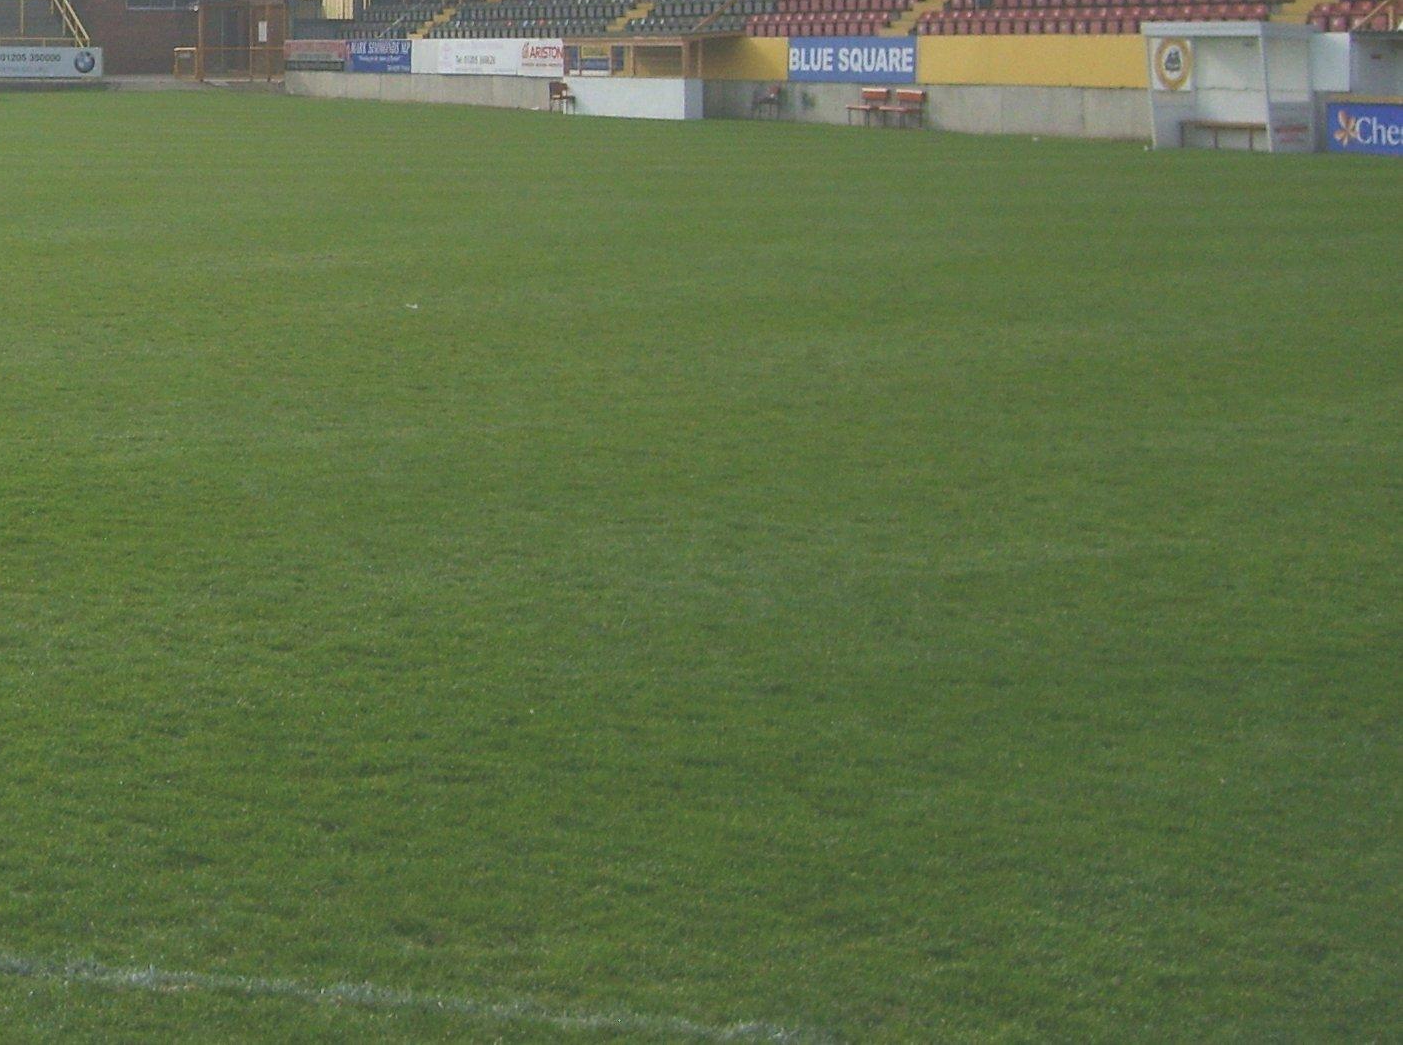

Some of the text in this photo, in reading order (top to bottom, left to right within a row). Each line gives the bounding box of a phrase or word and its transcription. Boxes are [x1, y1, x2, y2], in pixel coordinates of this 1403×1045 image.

[0, 54, 27, 62] 01205
[530, 46, 564, 58] ARISTON
[789, 47, 914, 73] BLUE SQUARE
[1355, 117, 1403, 145] Che
